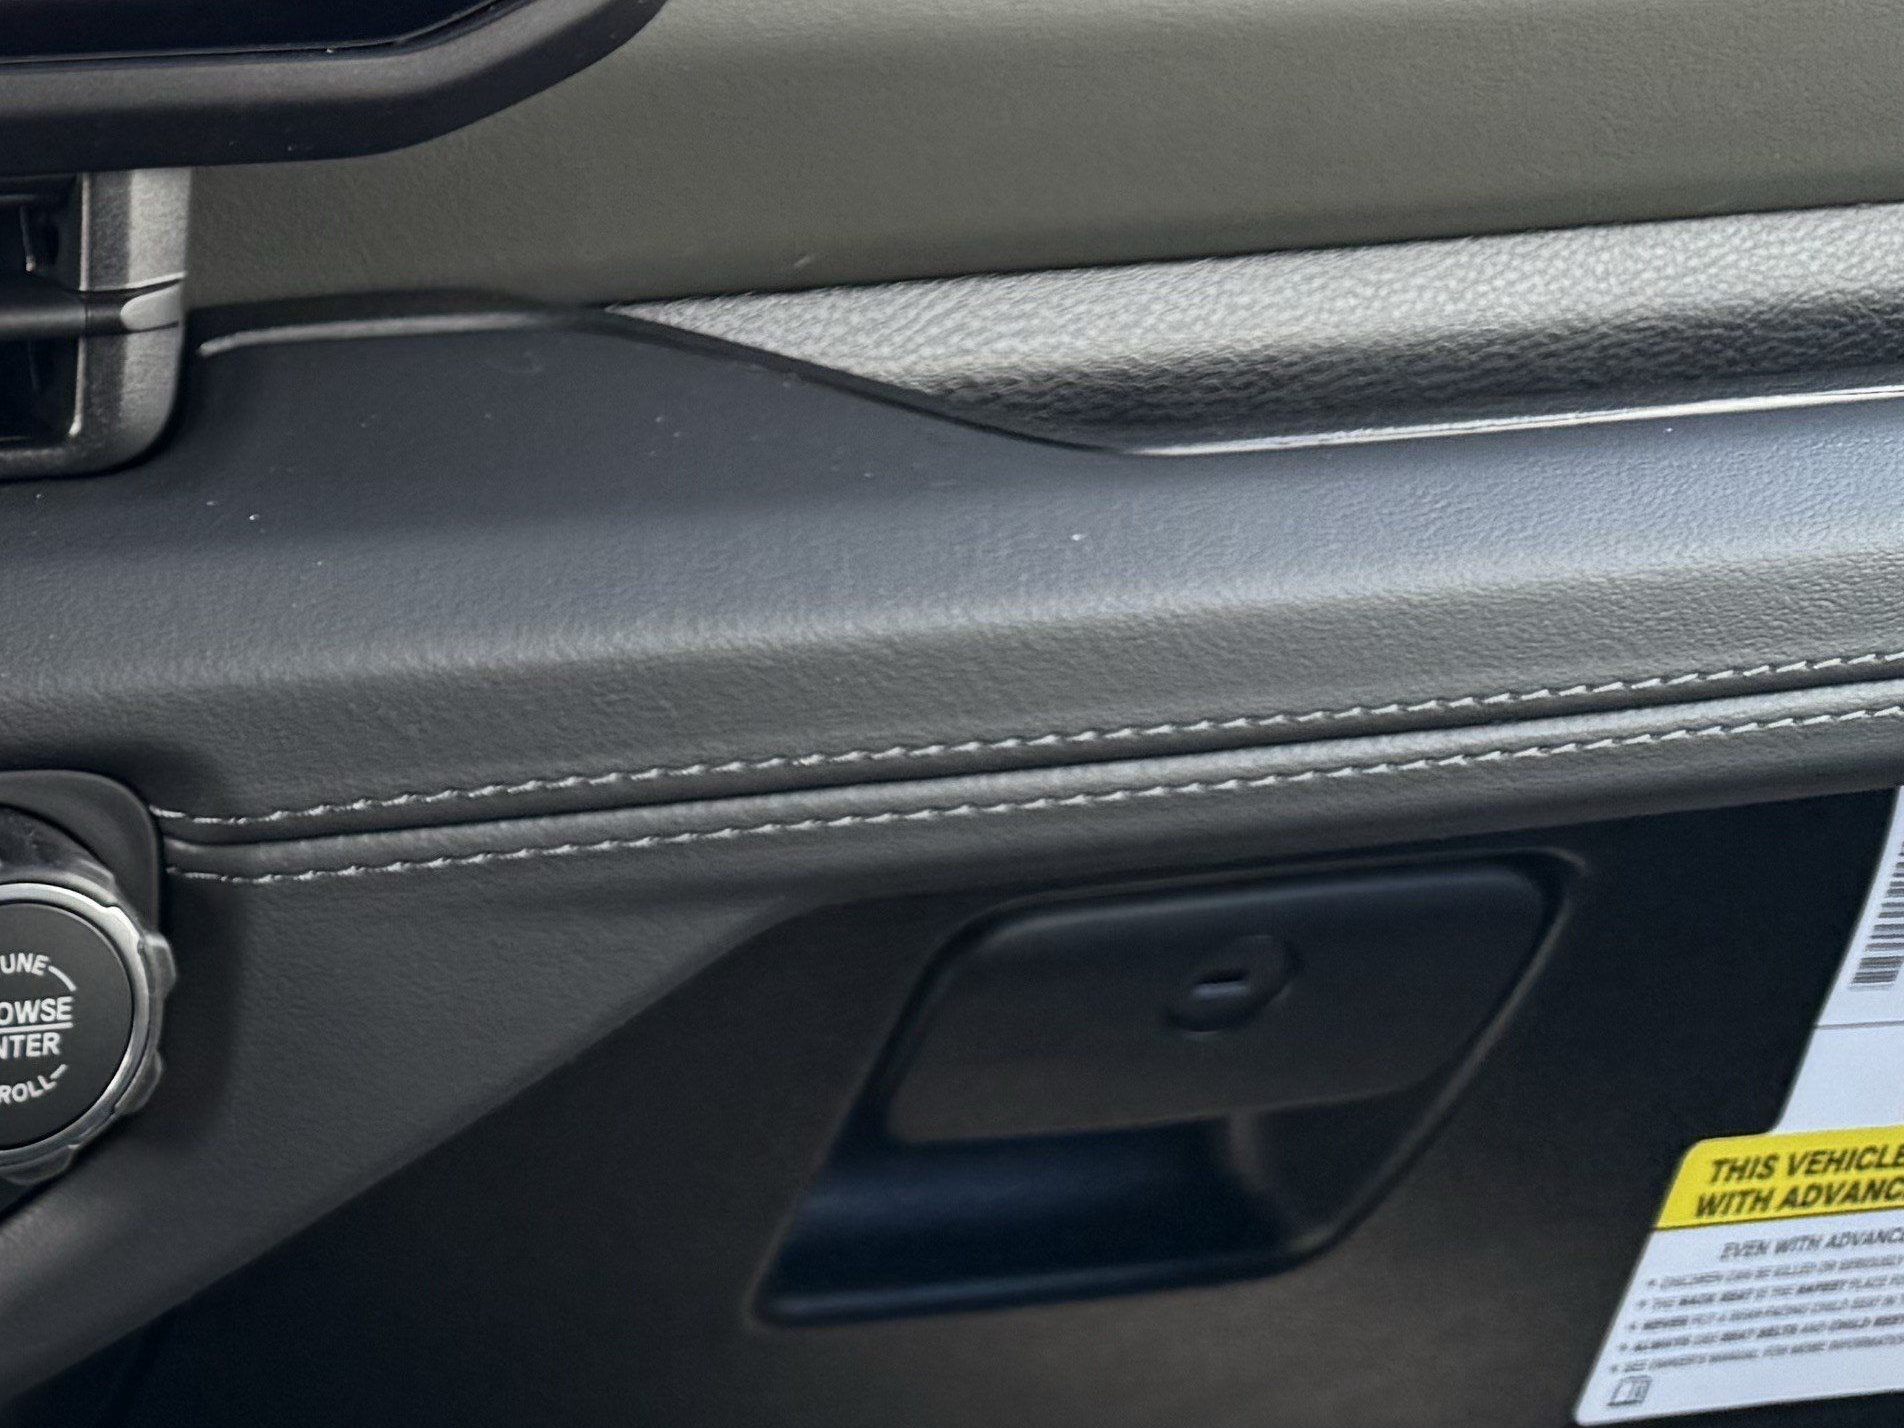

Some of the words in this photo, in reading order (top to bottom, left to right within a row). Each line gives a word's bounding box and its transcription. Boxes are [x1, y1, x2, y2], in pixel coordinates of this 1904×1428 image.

[1709, 1152, 1780, 1185] THIS
[1787, 1143, 1904, 1177] VEHICLE
[1695, 1185, 1775, 1218] WITH
[1824, 1225, 1904, 1250] ADVANC
